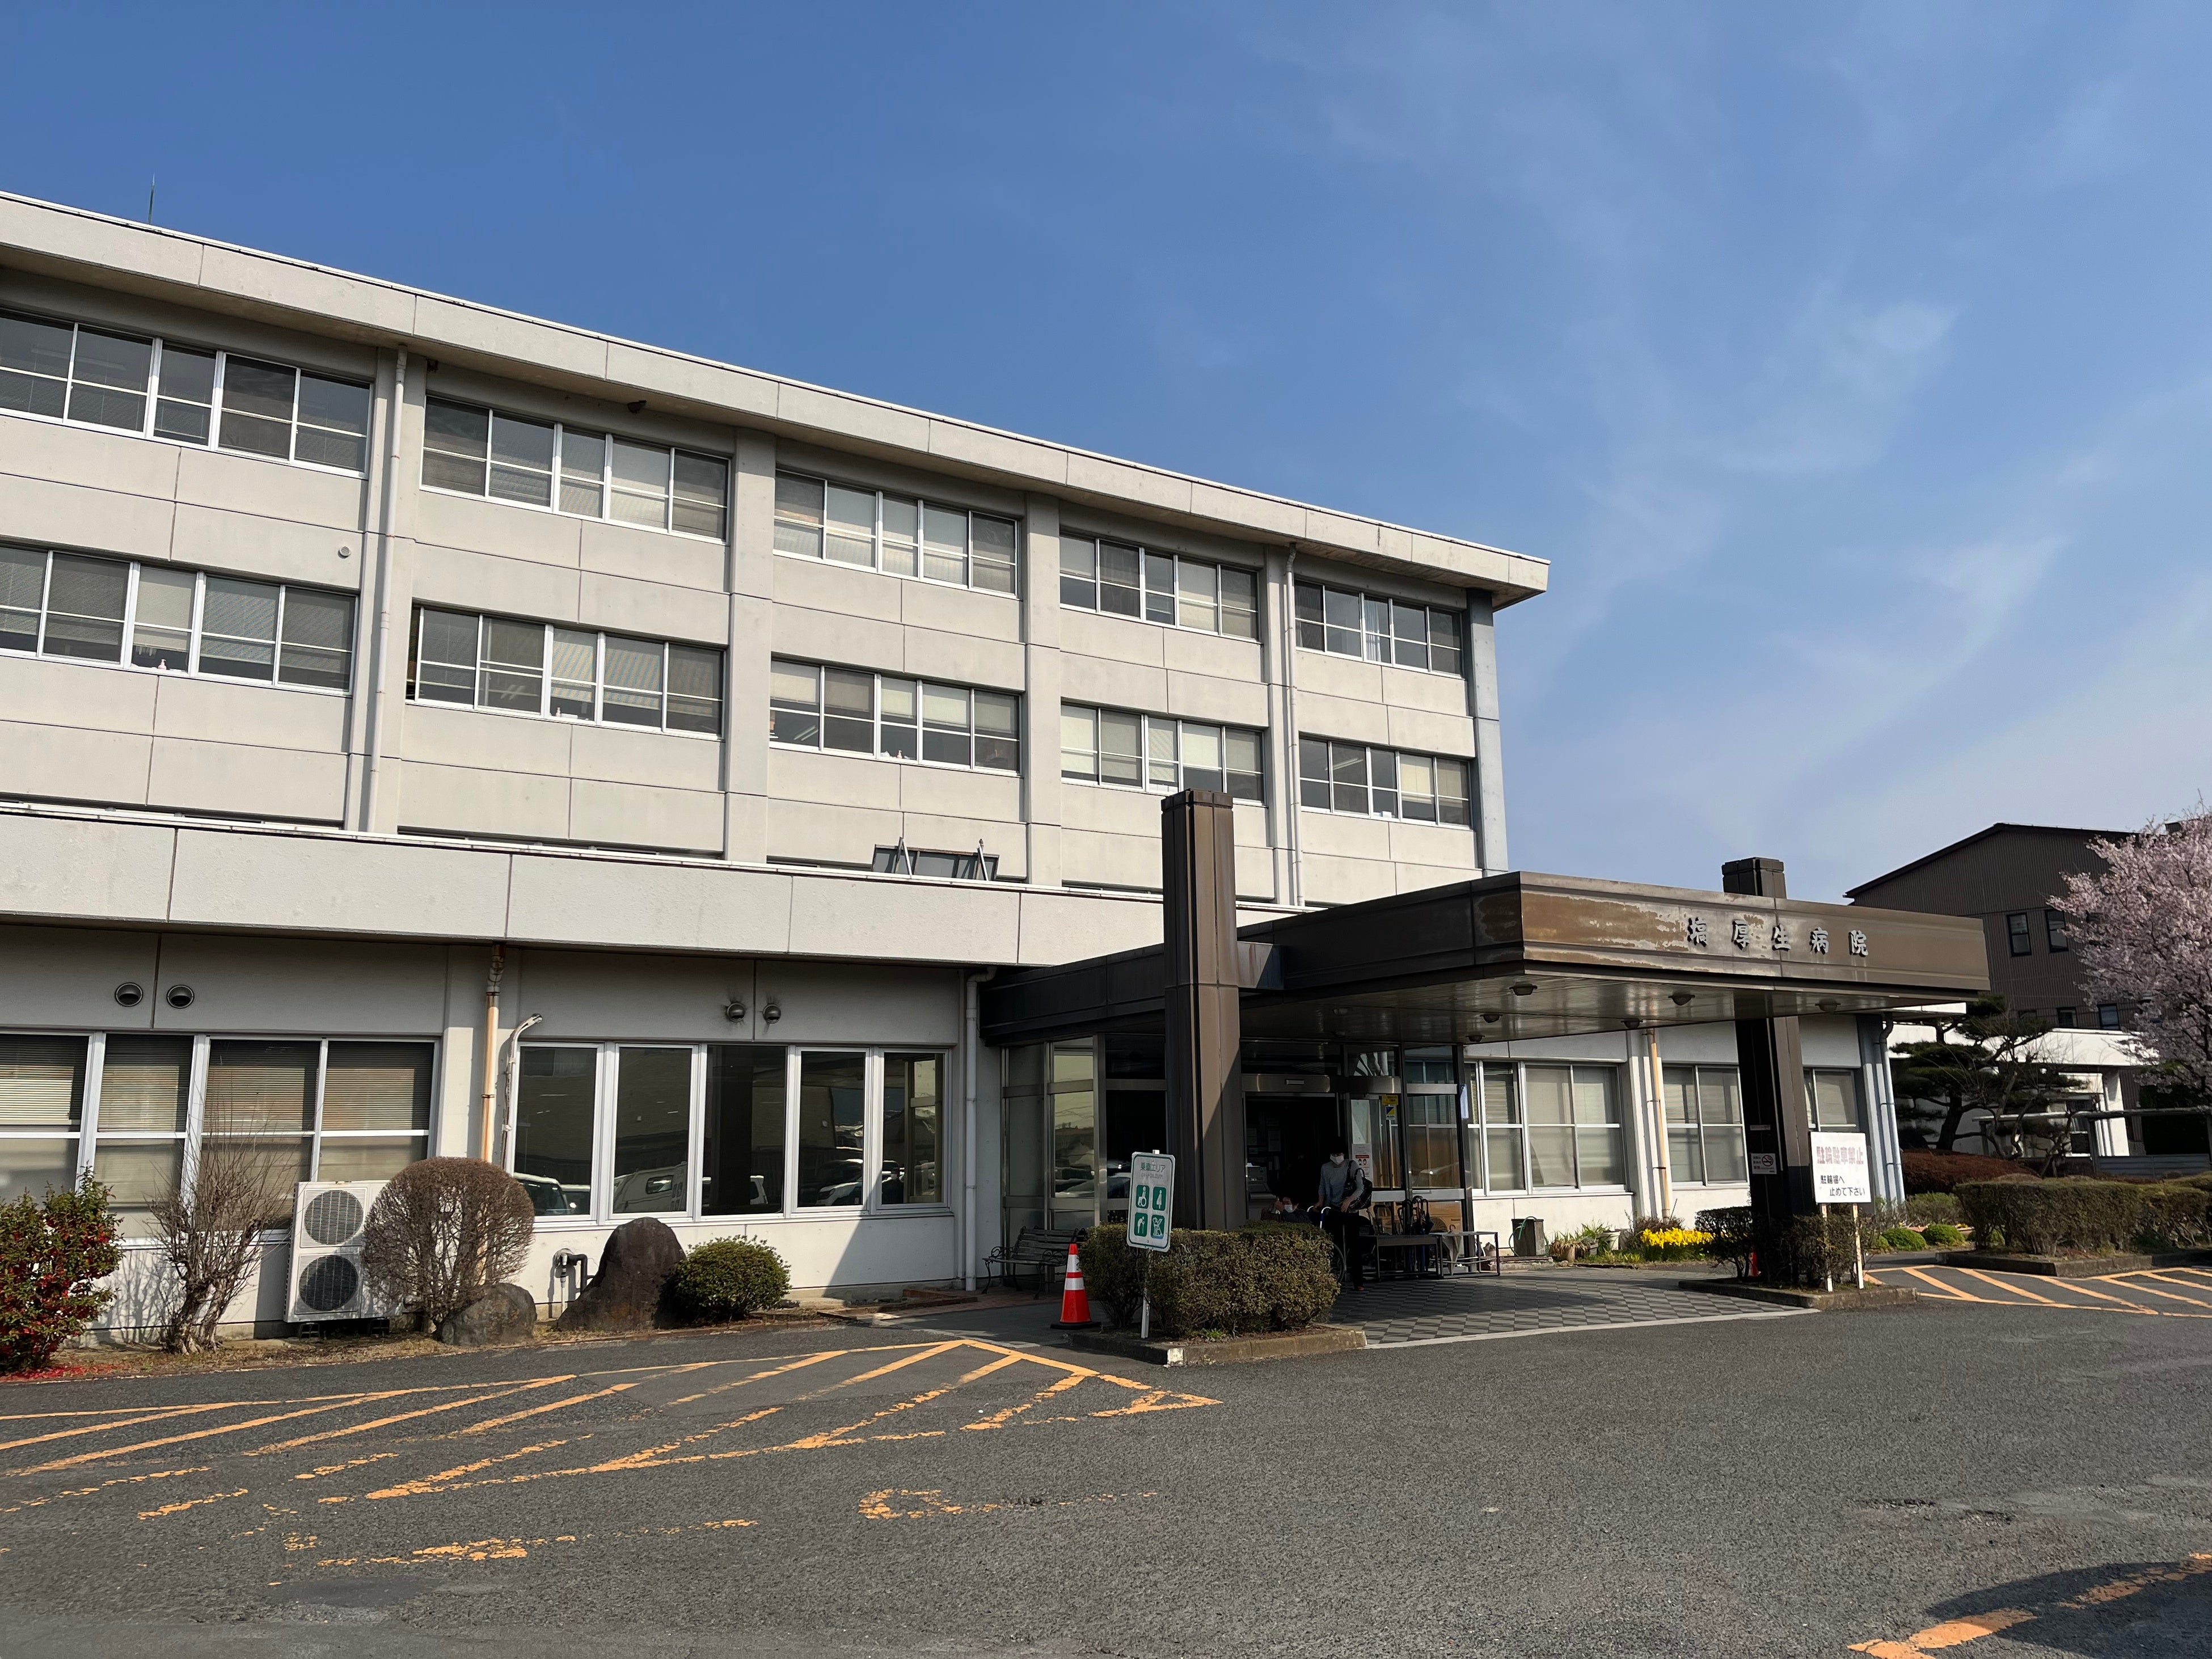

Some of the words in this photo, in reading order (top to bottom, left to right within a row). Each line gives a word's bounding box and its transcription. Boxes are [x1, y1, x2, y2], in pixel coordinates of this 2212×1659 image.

[1688, 917, 1869, 956] 塙厚生病院
[1816, 1146, 1864, 1164] 駐輪駐車禁止
[1820, 1175, 1845, 1184] 駐輪場へ
[1830, 1187, 1865, 1196] 止めて下さい
